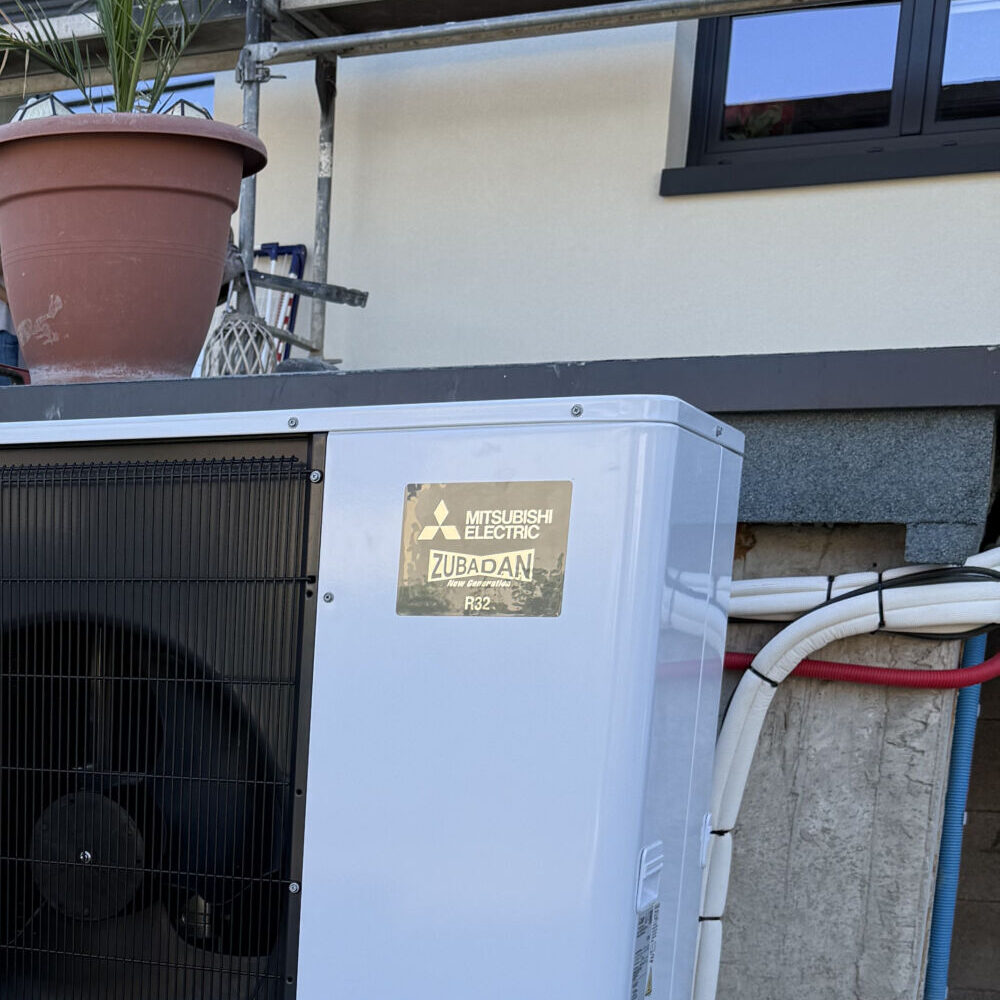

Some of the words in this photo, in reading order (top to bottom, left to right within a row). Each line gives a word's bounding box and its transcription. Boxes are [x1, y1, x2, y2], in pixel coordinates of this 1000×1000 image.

[465, 509, 553, 525] MITSUBISHI
[464, 525, 540, 540] ELECTRIC
[431, 552, 532, 579] ZUBADAN
[447, 580, 464, 588] New
[467, 579, 512, 588] Generation
[464, 595, 491, 611] R32
